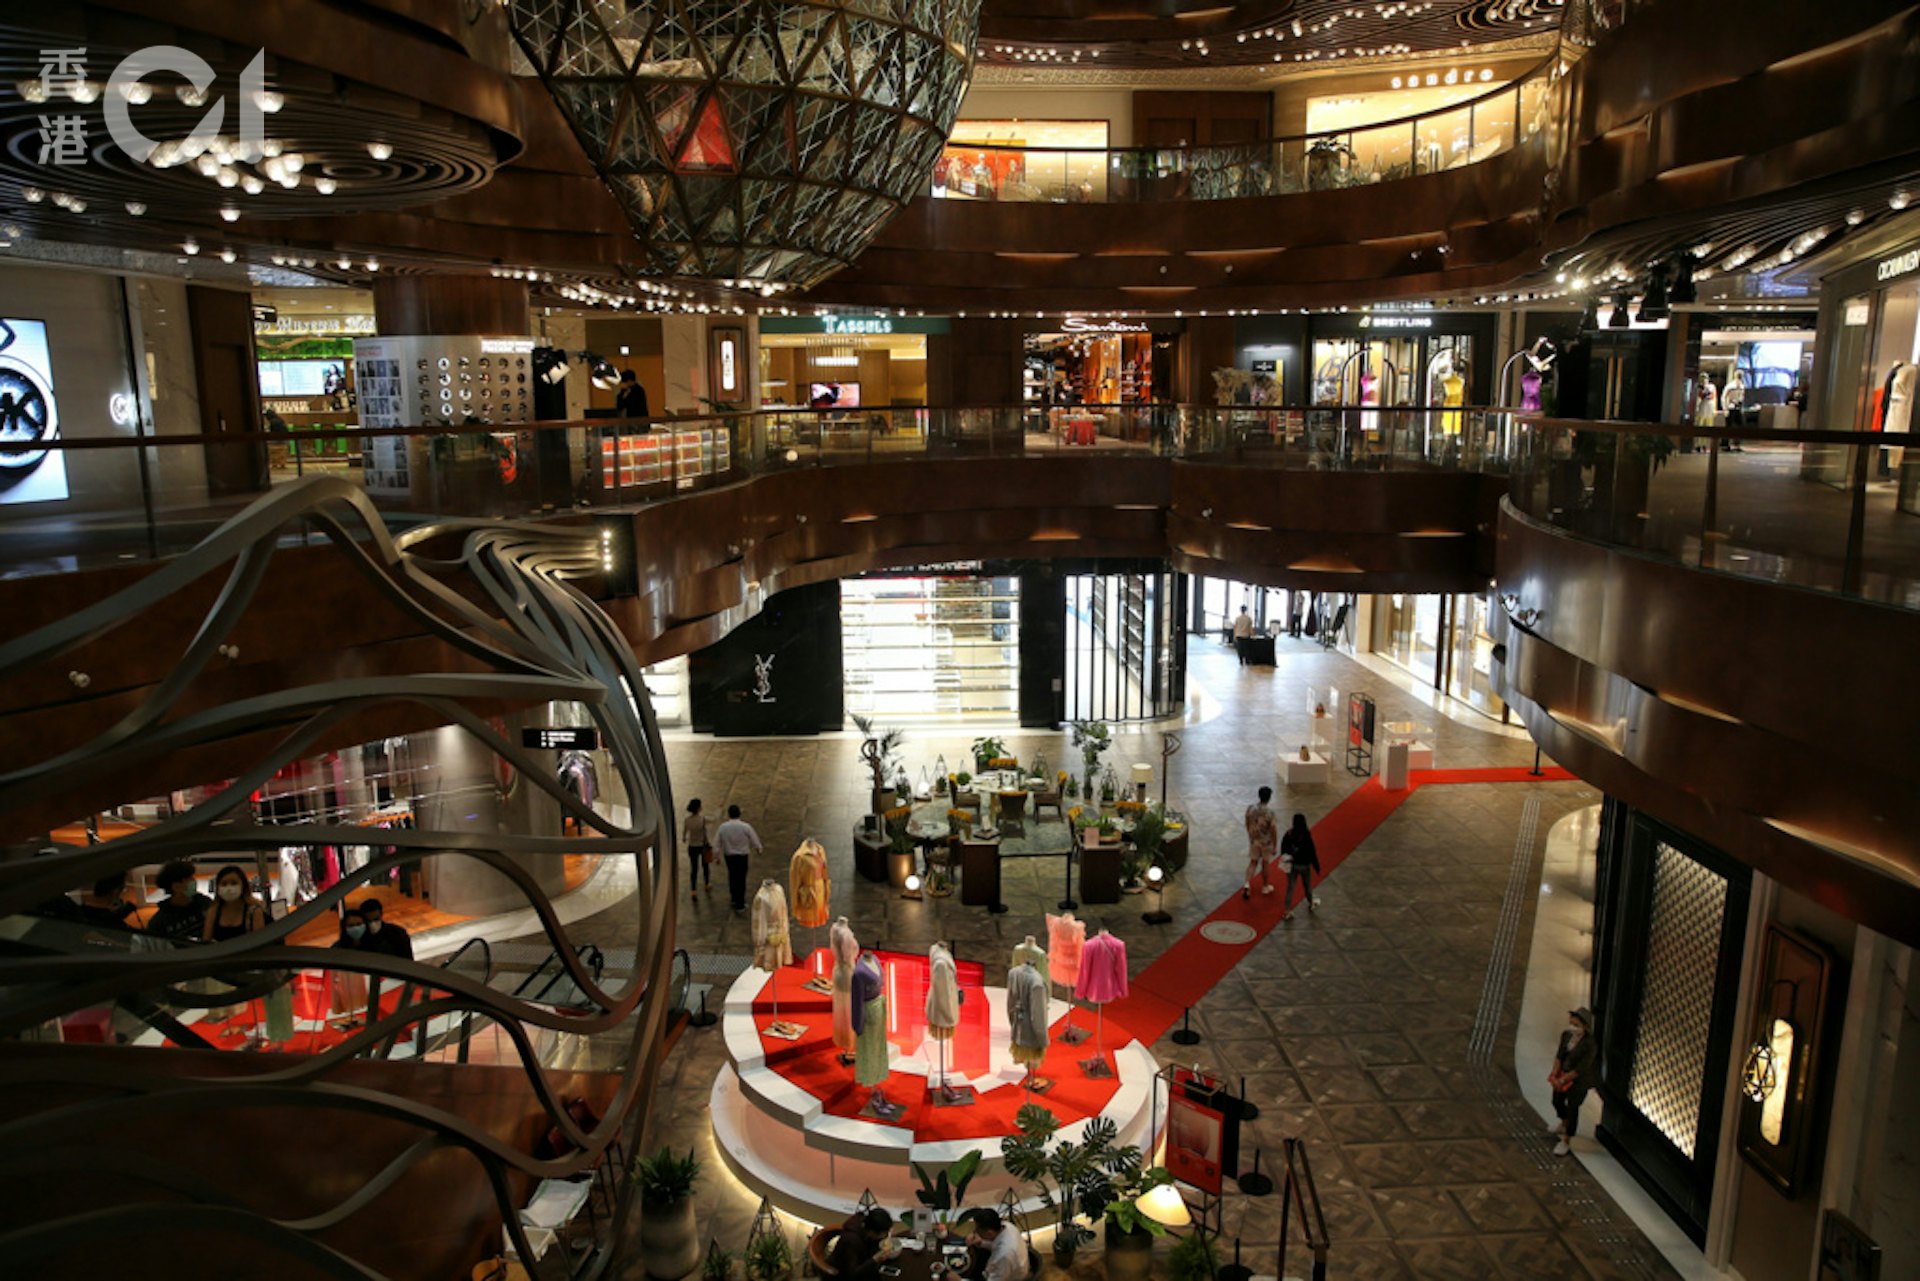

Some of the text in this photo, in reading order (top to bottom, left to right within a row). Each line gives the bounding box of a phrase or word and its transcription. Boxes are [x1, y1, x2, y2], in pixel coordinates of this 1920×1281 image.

[1391, 67, 1494, 90] sandro
[1060, 317, 1149, 332] Santoni
[1372, 317, 1432, 328] BREITLING
[752, 653, 777, 703] YSL
